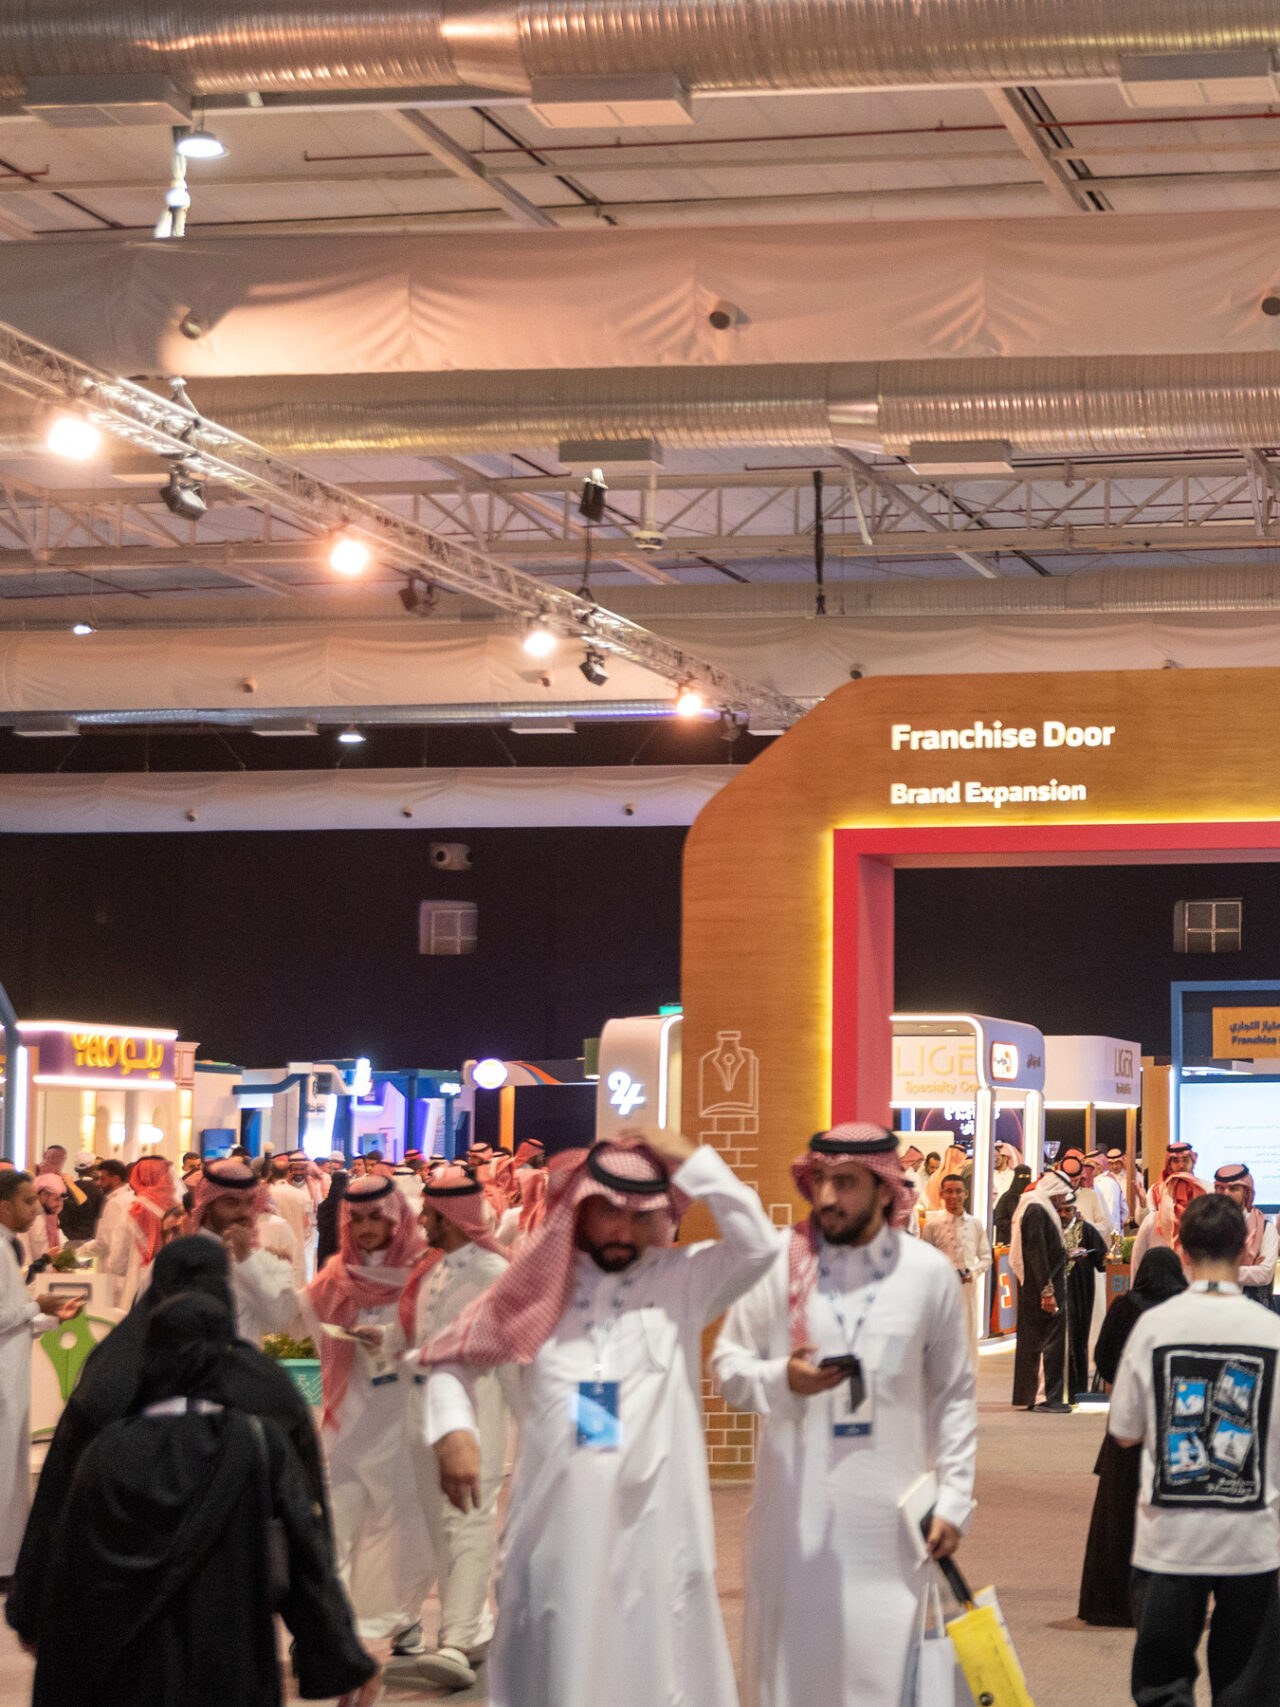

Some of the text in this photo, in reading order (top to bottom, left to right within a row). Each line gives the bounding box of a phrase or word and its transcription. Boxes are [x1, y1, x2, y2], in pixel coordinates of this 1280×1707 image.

[891, 720, 1116, 750] Franchise Door
[890, 778, 1087, 808] Brand Expansion
[1231, 1034, 1277, 1045] Franchise
[895, 1045, 978, 1076] LIGE
[905, 1080, 957, 1095] Specialty
